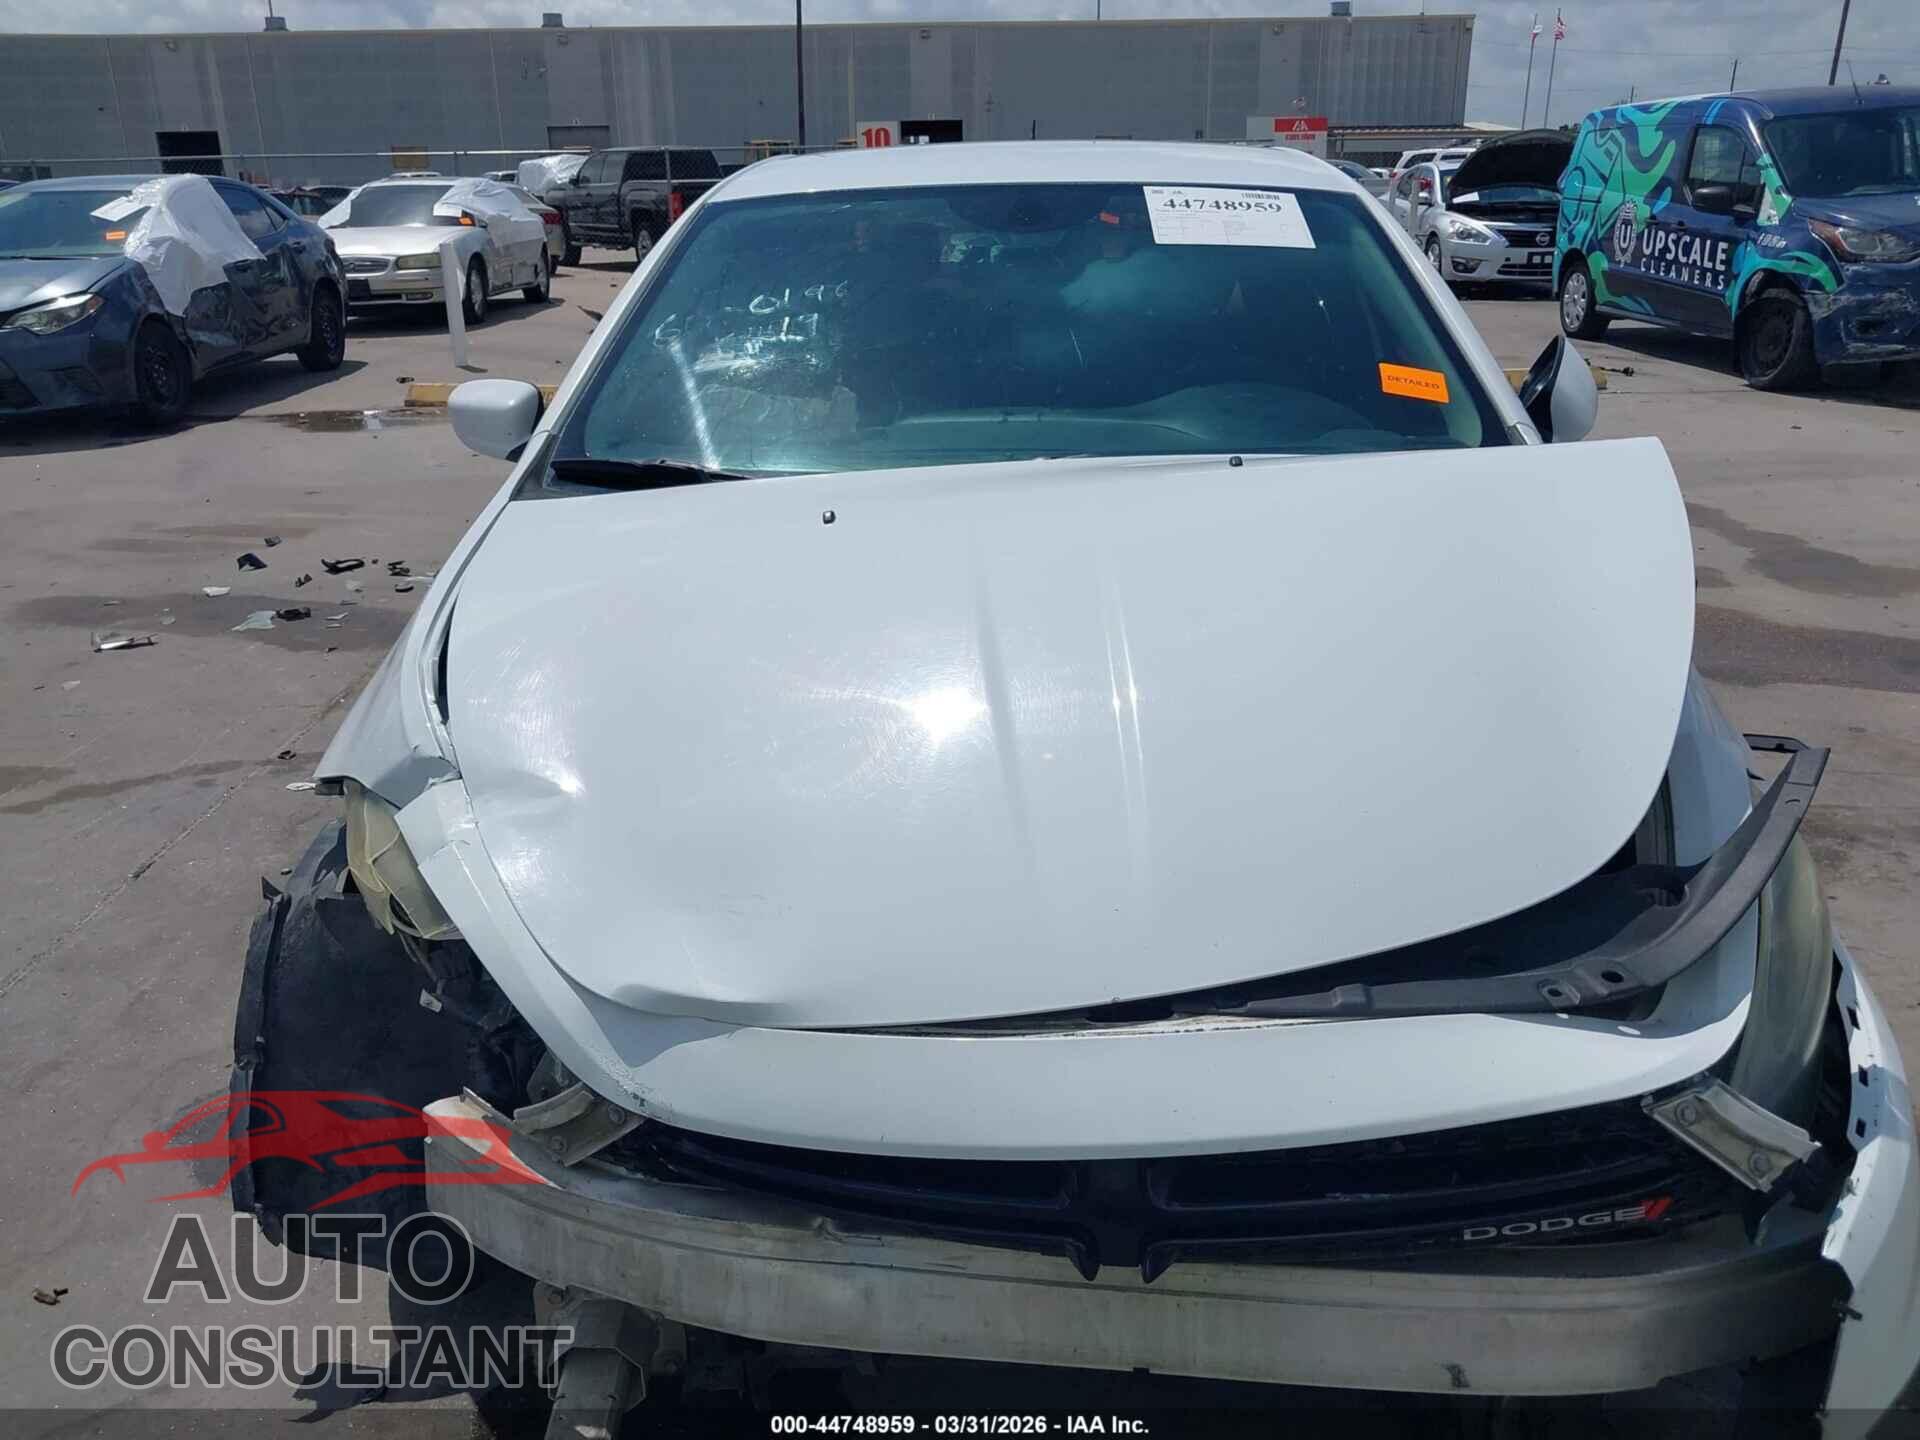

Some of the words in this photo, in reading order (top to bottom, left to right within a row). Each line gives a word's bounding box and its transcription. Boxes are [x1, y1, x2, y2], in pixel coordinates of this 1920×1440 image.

[862, 128, 891, 148] 10
[1163, 198, 1282, 213] 44748959
[1642, 228, 1728, 271] UPSCALE
[1640, 258, 1725, 290] CLEANERS
[1463, 1206, 1646, 1240] DODGE
